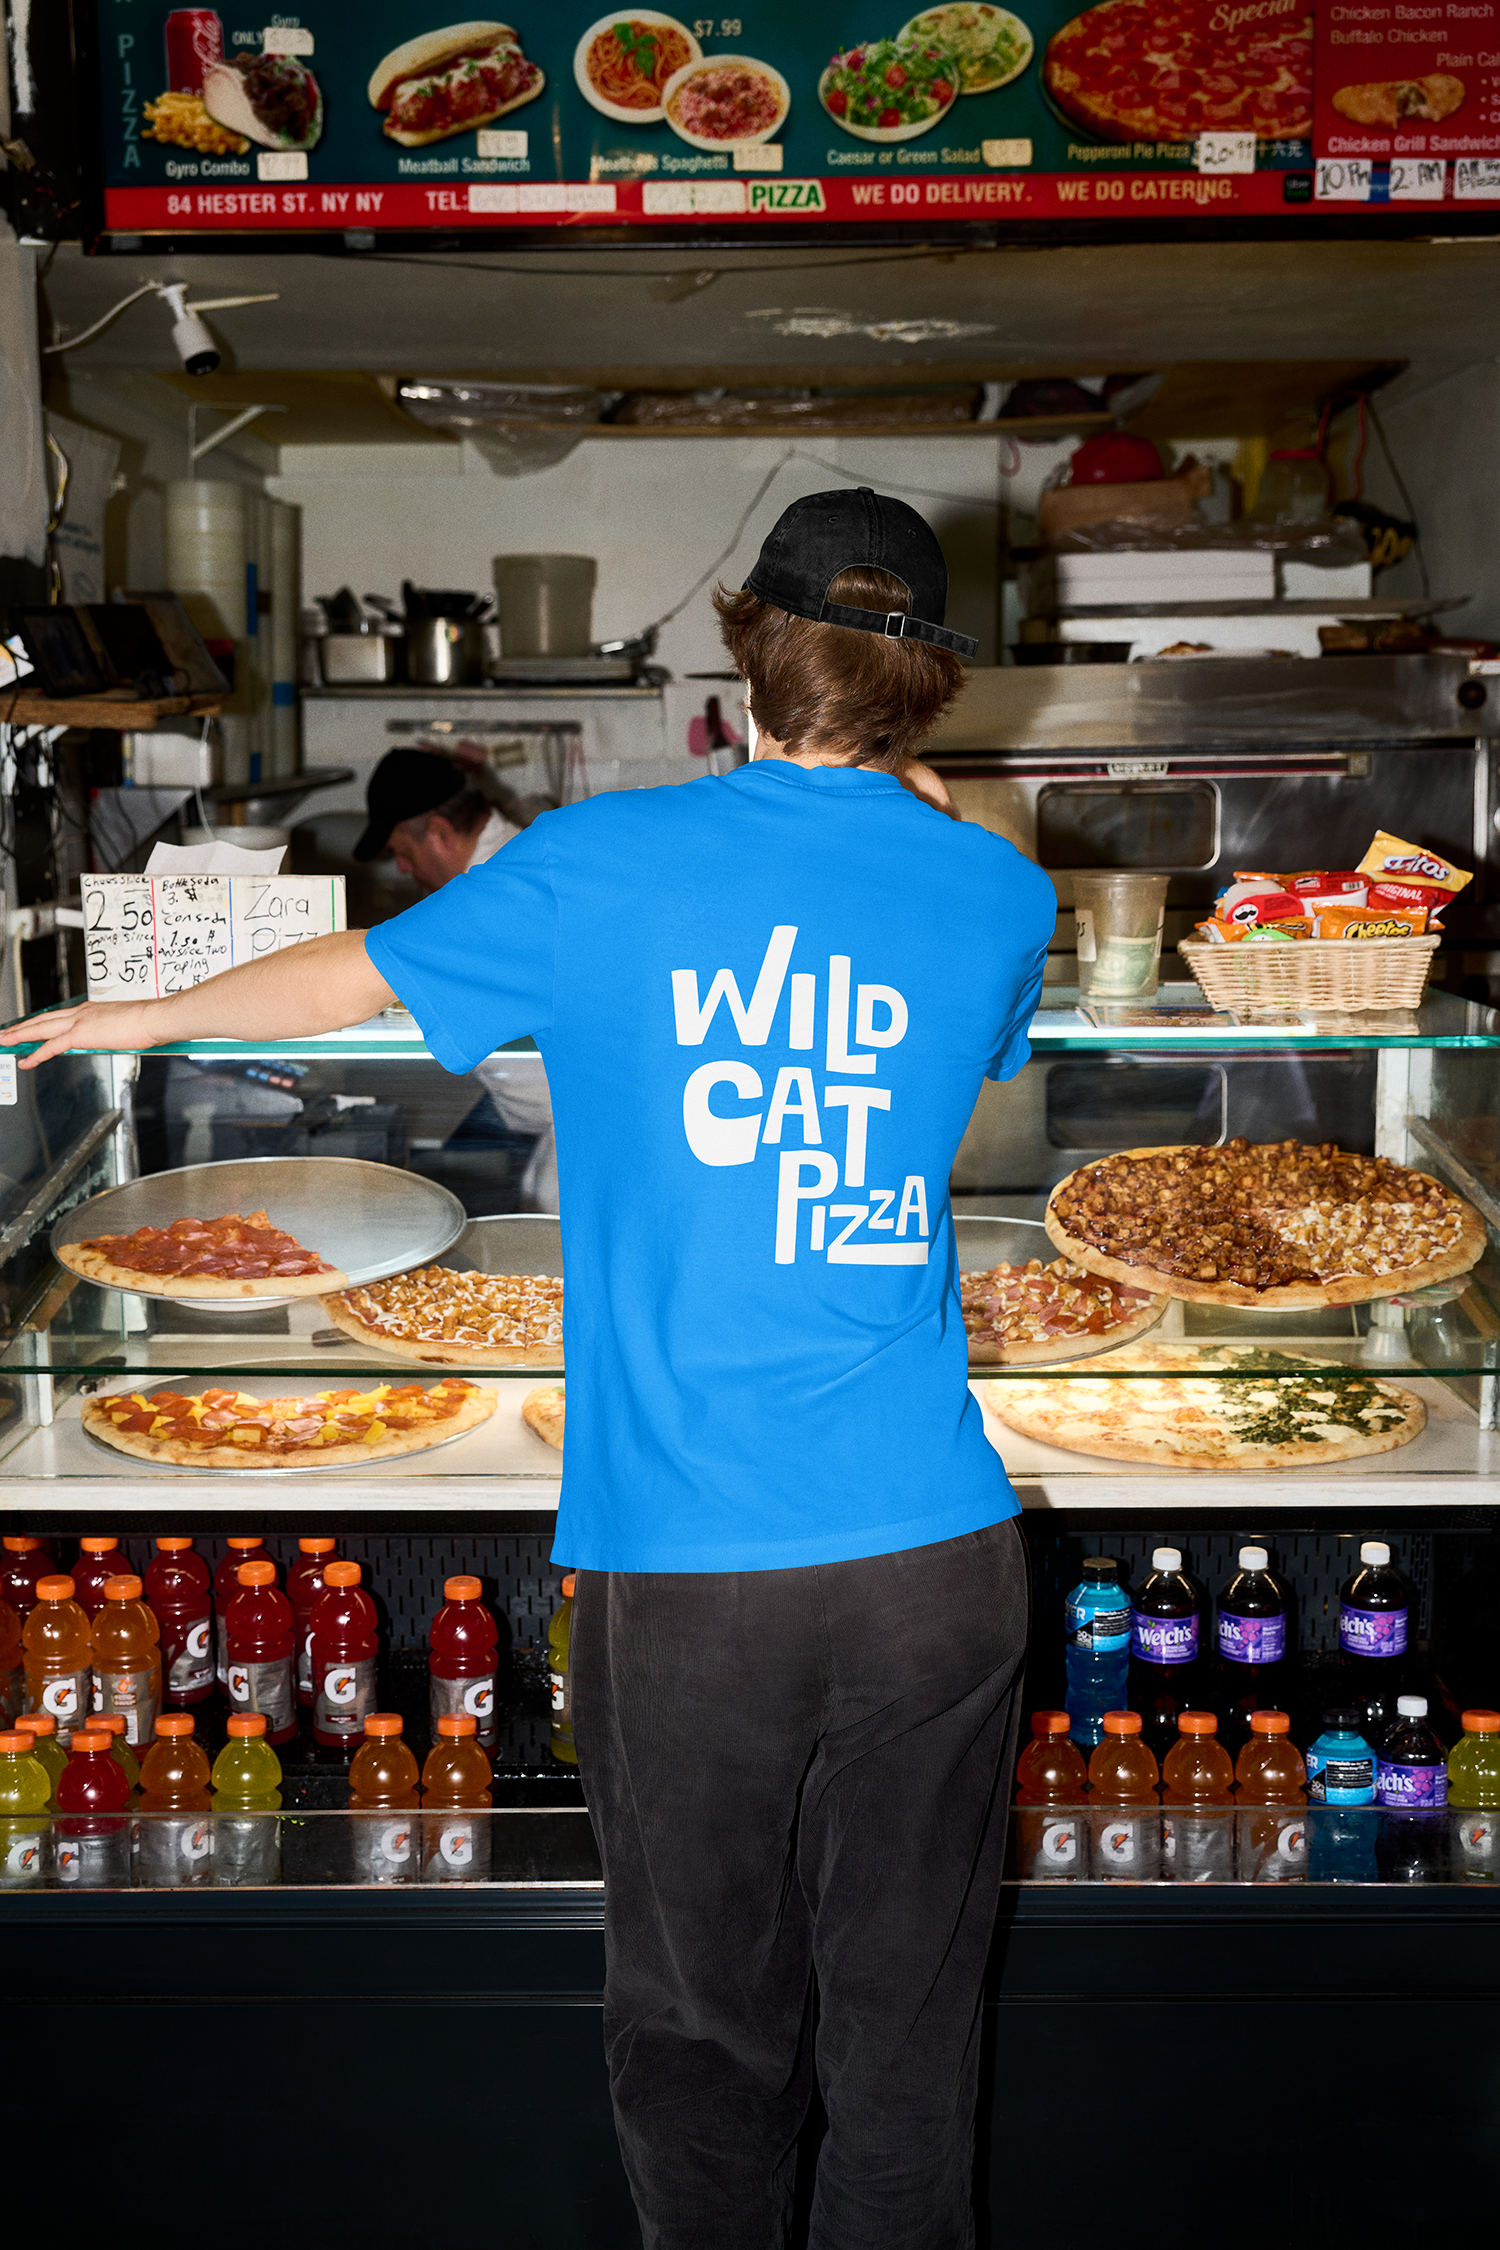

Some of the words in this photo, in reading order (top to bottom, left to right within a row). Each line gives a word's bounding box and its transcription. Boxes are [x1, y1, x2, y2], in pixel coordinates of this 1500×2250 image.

[1330, 5, 1391, 21] Chicken
[1395, 5, 1442, 20] Bacon
[1446, 4, 1494, 18] Ranch
[693, 18, 742, 38] $7.99
[1330, 29, 1383, 44] Buffalo
[1387, 28, 1448, 43] Chicken
[1436, 51, 1473, 68] Plain
[1067, 143, 1132, 163] Pepperoni
[1134, 143, 1155, 159] Pie
[1156, 143, 1190, 159] Pizza
[1327, 136, 1391, 153] Chicken
[1394, 135, 1427, 152] Grill
[398, 158, 458, 174] Meatball
[461, 156, 530, 173] Sandwich
[661, 154, 728, 174] Spaghetti
[827, 149, 875, 165] Caesar
[878, 151, 893, 165] or
[896, 148, 938, 164] Green
[940, 147, 981, 163] Salad
[166, 160, 197, 180] Gyro
[200, 159, 250, 177] Combo
[166, 195, 193, 215] 84
[197, 193, 277, 214] HESTER
[282, 192, 315, 213] ST.
[321, 192, 351, 212] NY
[355, 192, 384, 211] NY
[752, 186, 821, 208] PIZZA
[851, 183, 885, 205] WE
[890, 183, 919, 205] DO
[926, 181, 1033, 204] DELIVERY.
[1056, 180, 1090, 201] WE
[1095, 180, 1125, 201] DO
[1130, 178, 1240, 202] CATERING.
[243, 883, 310, 921] Zara
[670, 924, 909, 1075] WILD
[682, 1059, 892, 1188] CAT
[774, 1149, 930, 1266] PIZZA
[1137, 1625, 1193, 1646] Welch's
[43, 1677, 77, 1715] G
[324, 1667, 357, 1705] G
[464, 1678, 494, 1718] G
[1042, 1822, 1076, 1862] G
